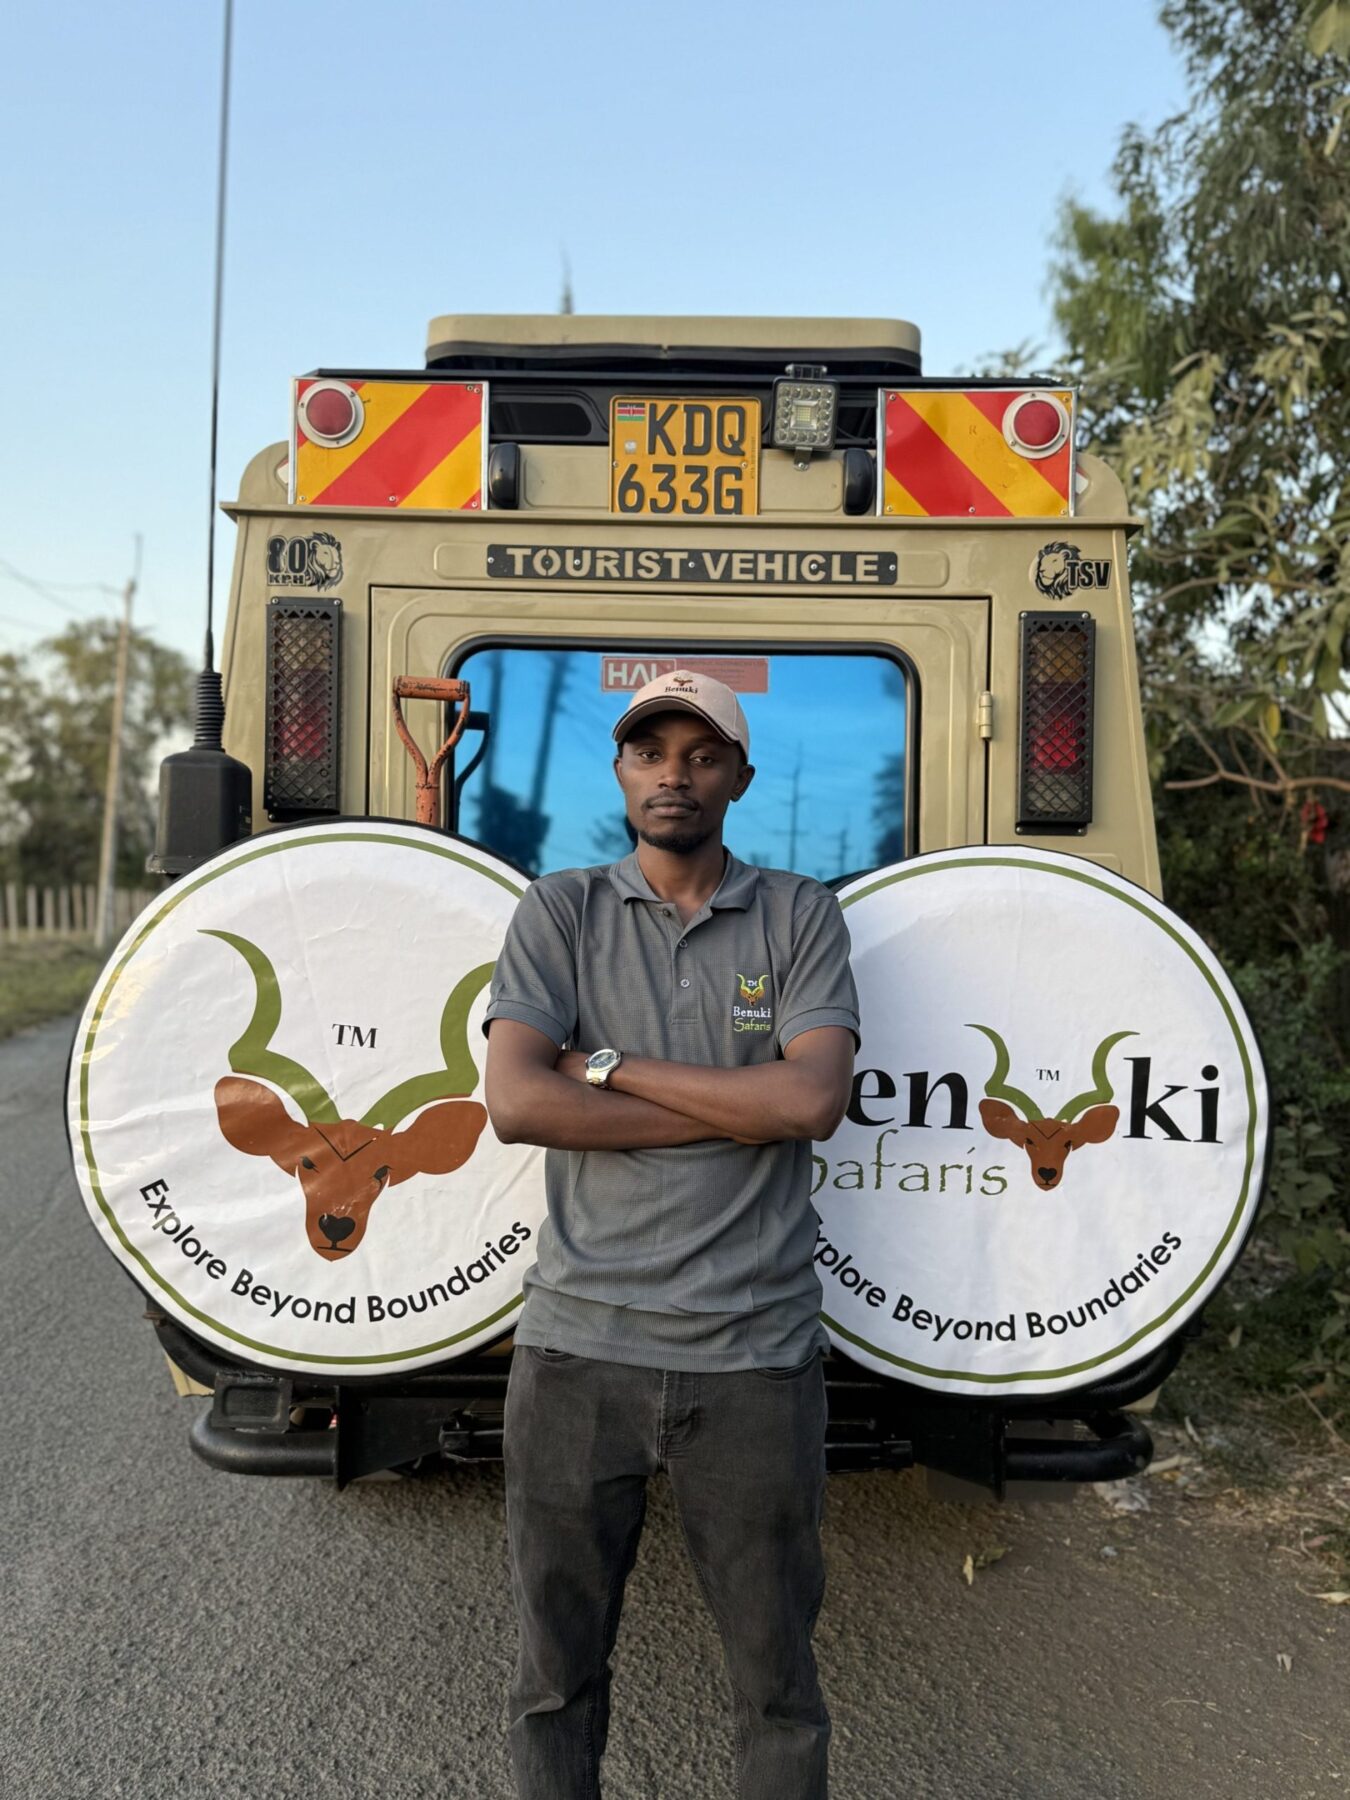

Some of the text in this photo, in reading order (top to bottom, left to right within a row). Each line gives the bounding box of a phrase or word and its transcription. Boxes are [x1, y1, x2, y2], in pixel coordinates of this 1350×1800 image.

[648, 403, 746, 456] KDQ
[618, 464, 743, 515] 633G
[267, 536, 308, 574] 80
[506, 547, 880, 583] TOURIST VEHICLE
[268, 573, 305, 585] KPH
[1066, 560, 1110, 589] TSV
[733, 1006, 771, 1018] Benuki
[733, 1018, 771, 1032] Safaris
[331, 1023, 379, 1049] TM
[1035, 1068, 1061, 1082] TM
[845, 1068, 974, 1130] en
[139, 1178, 532, 1324] Explore Beyond Boundaries
[812, 1214, 1182, 1342] plore Beyond Boundaries
